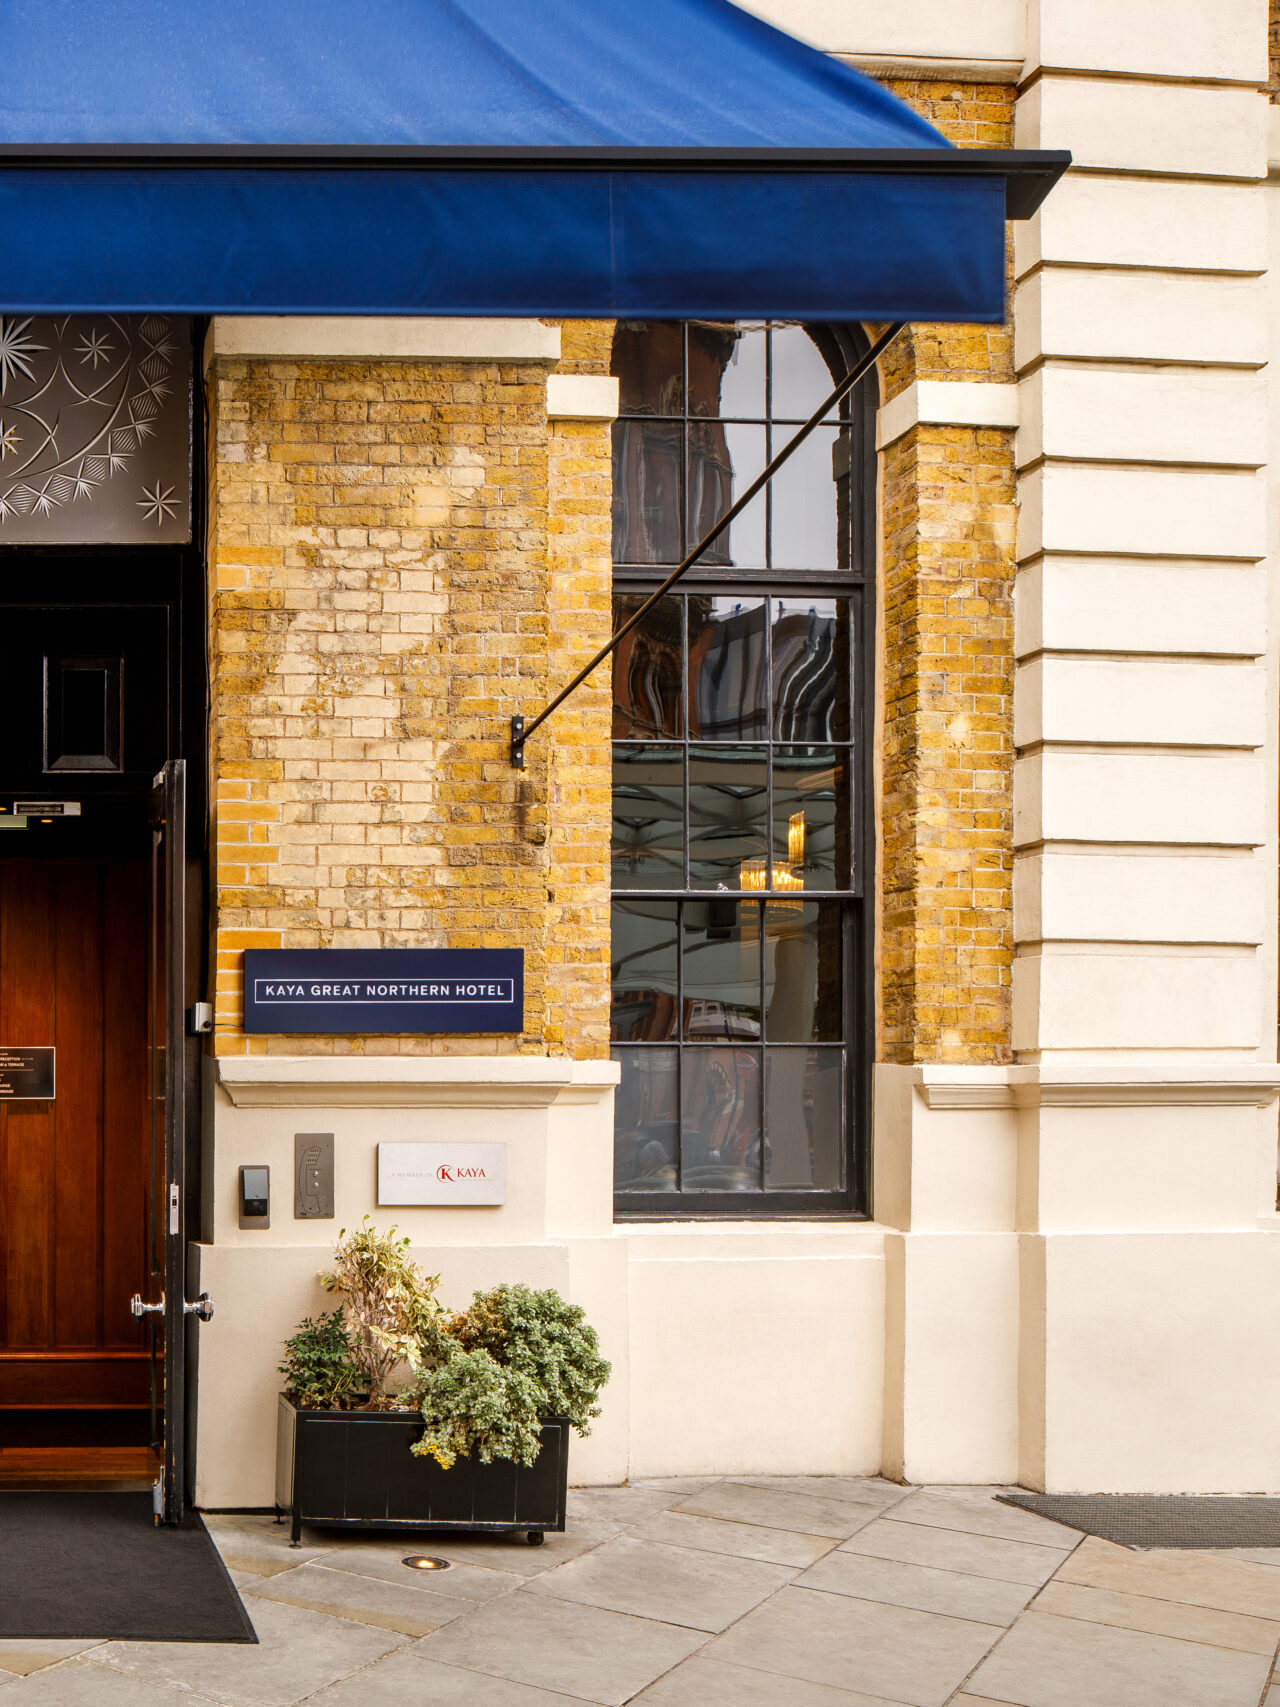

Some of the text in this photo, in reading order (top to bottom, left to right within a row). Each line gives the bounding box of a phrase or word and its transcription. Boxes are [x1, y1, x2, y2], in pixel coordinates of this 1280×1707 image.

[265, 984, 505, 996] KAYA GREAT NORTHERN HOTEL
[457, 1168, 487, 1178] KAYA
